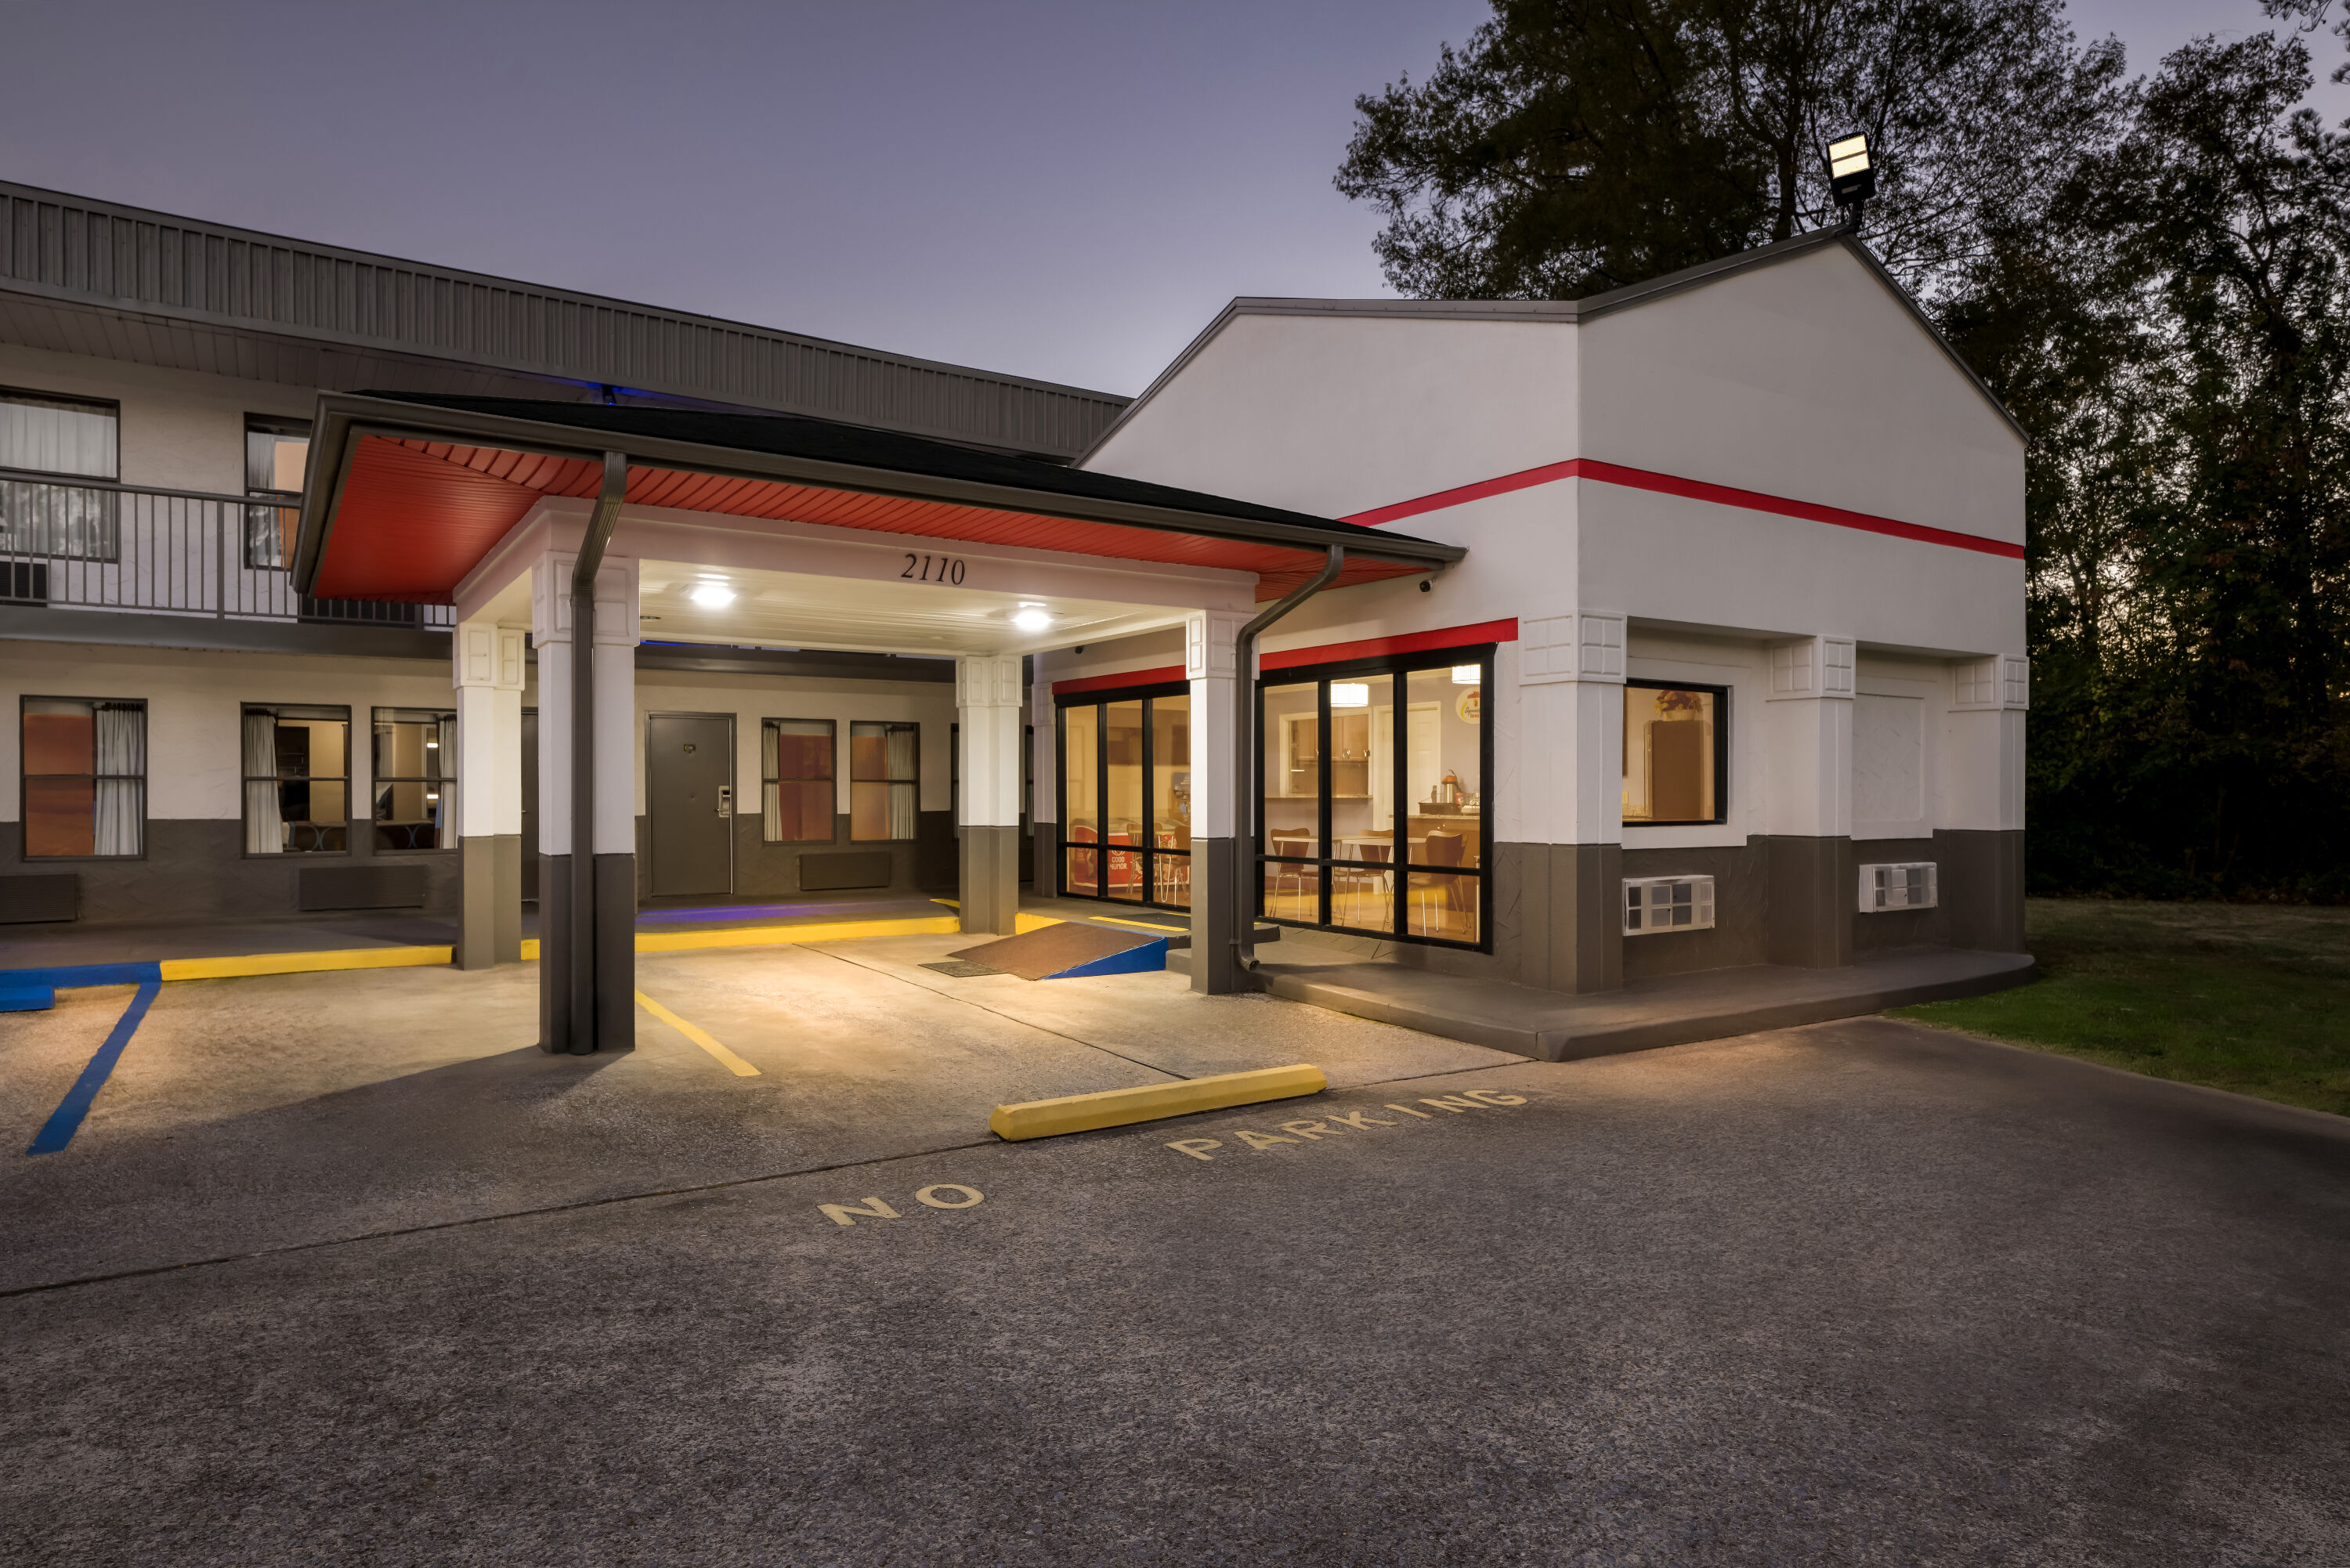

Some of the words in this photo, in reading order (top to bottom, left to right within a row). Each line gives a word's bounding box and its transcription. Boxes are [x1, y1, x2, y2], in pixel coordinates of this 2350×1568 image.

[901, 553, 965, 585] 2110
[816, 1183, 985, 1226] NO
[1164, 1089, 1528, 1161] PARKING
